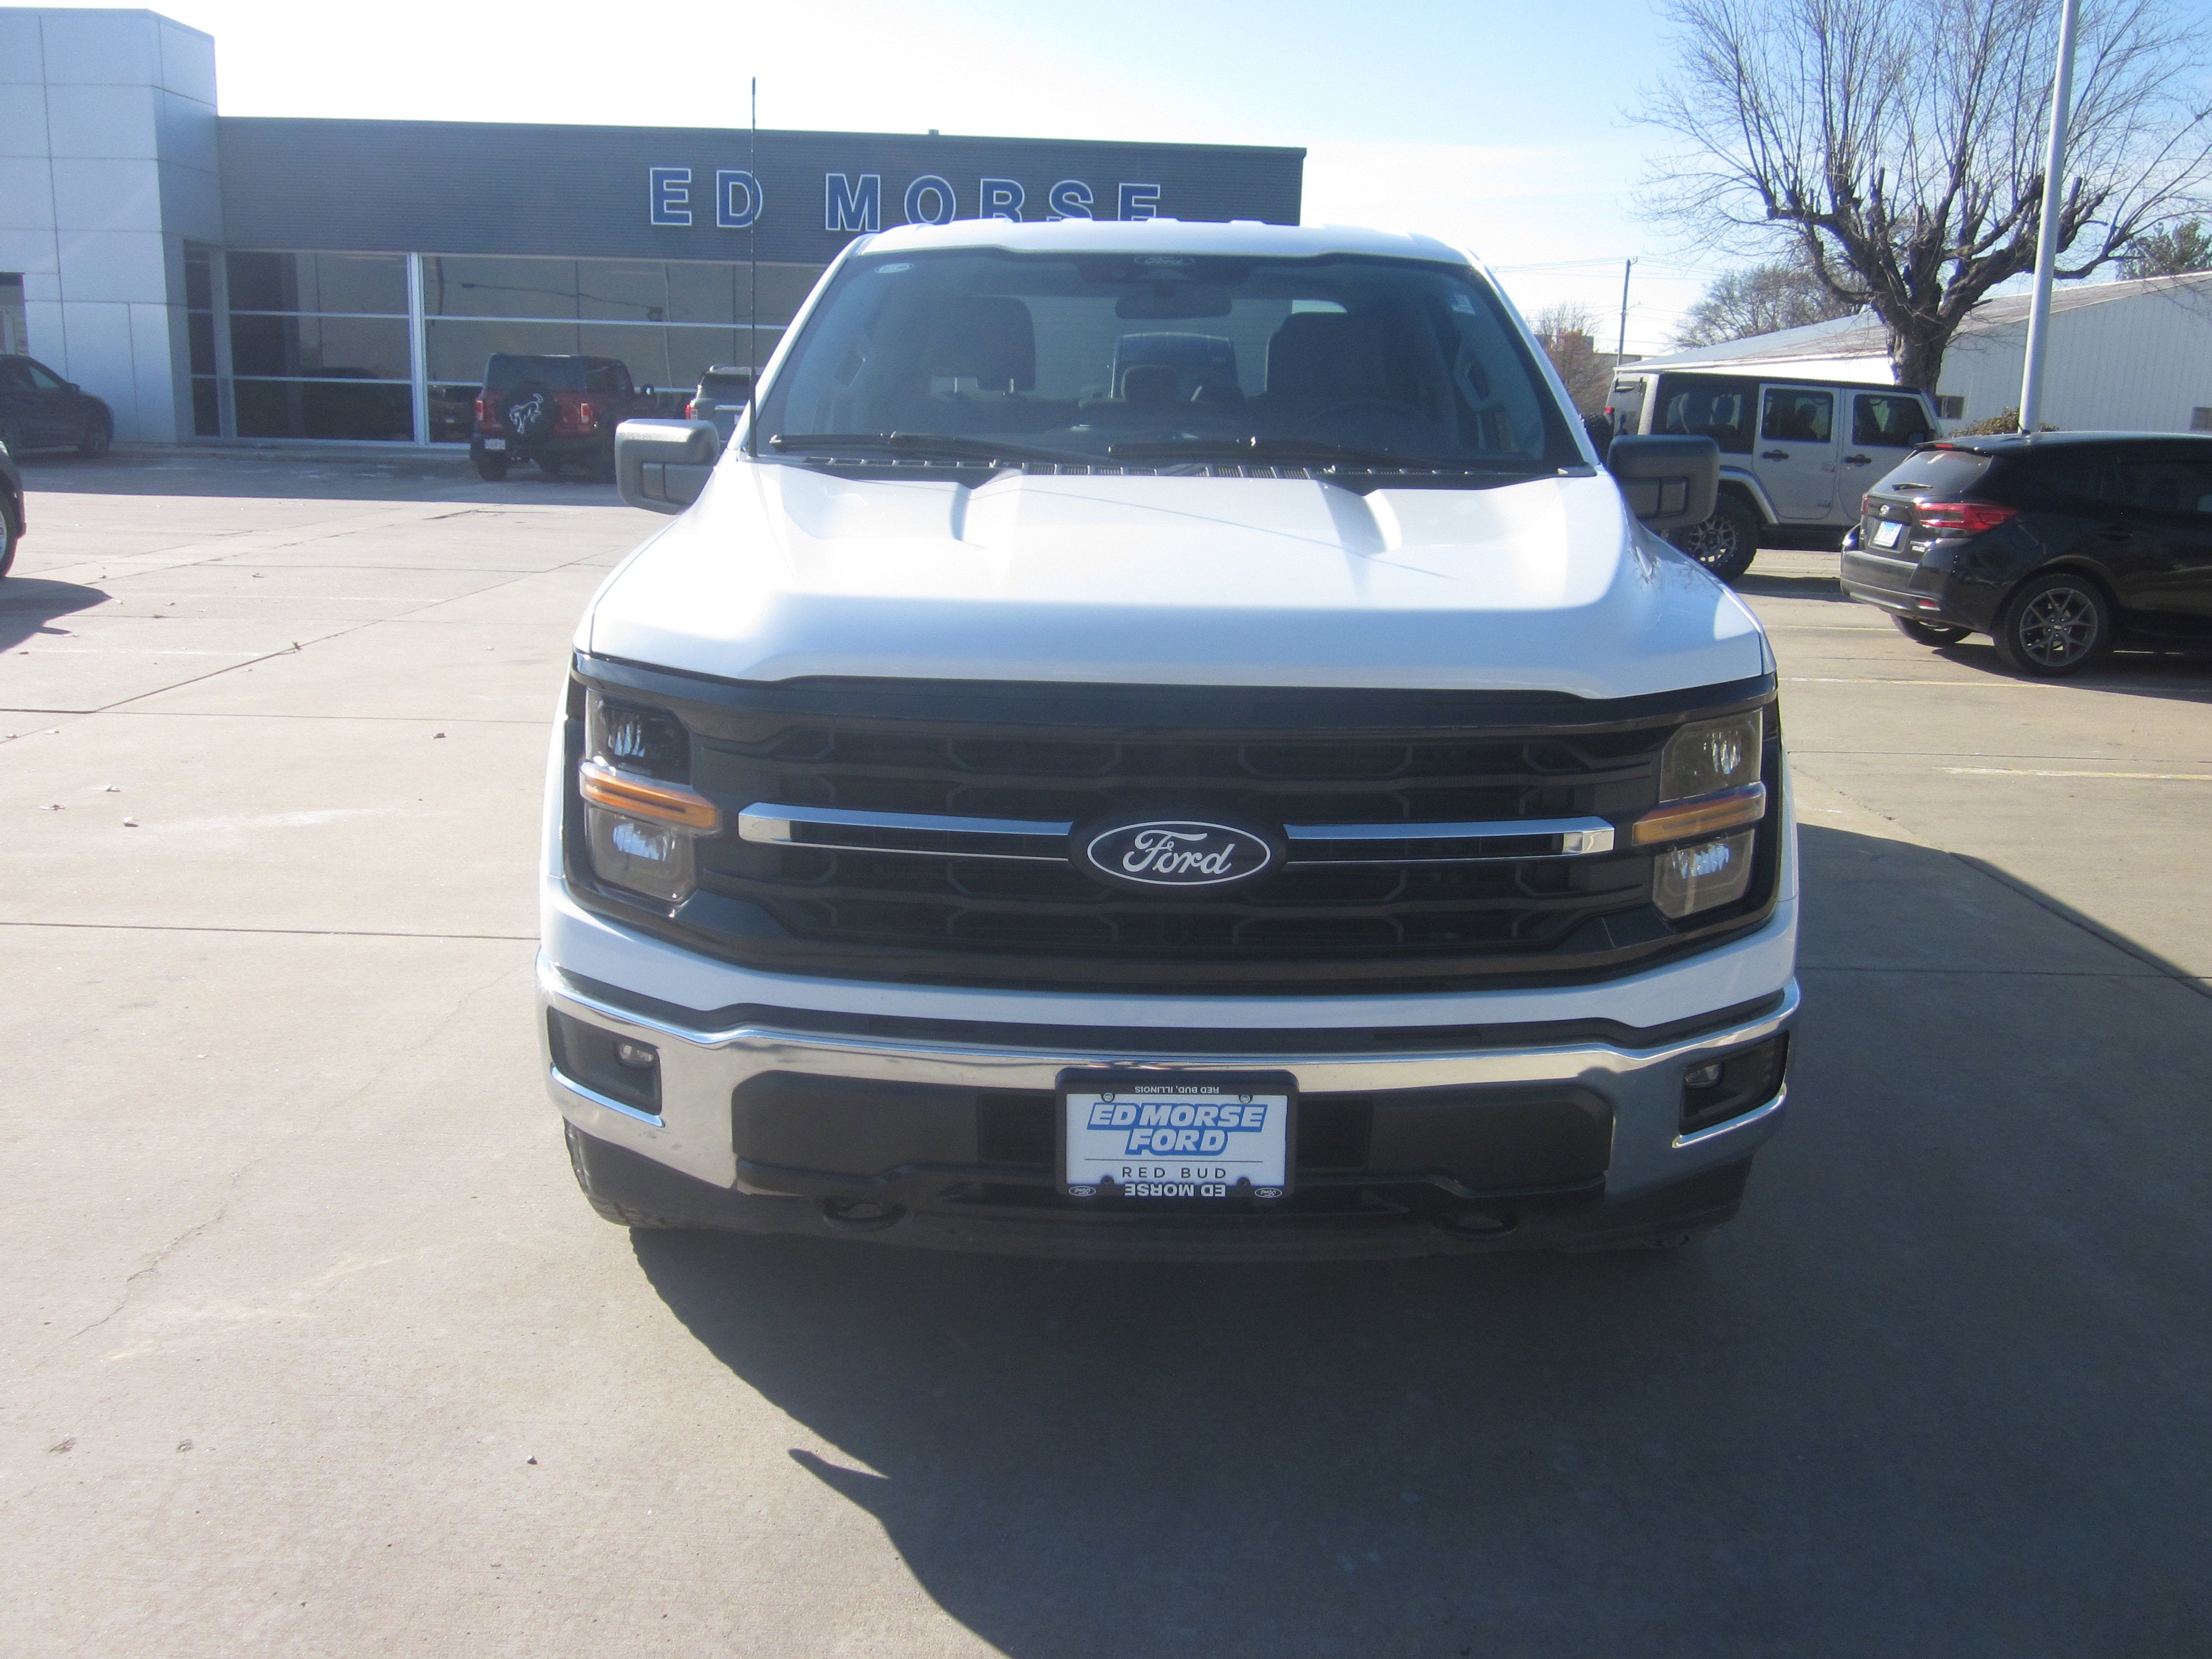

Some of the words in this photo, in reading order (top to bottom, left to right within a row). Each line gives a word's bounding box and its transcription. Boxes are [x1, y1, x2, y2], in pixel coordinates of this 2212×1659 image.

[650, 168, 763, 228] ED
[825, 173, 1161, 232] MORSE
[1123, 830, 1235, 874] Ford
[1089, 1105, 1136, 1126] ED
[1139, 1105, 1265, 1128] MORSE
[1128, 1128, 1227, 1152] FORD
[1122, 1167, 1166, 1178] RED
[1181, 1167, 1227, 1179] BUD
[1124, 1183, 1194, 1197] MORSE
[1201, 1184, 1226, 1197] ED
